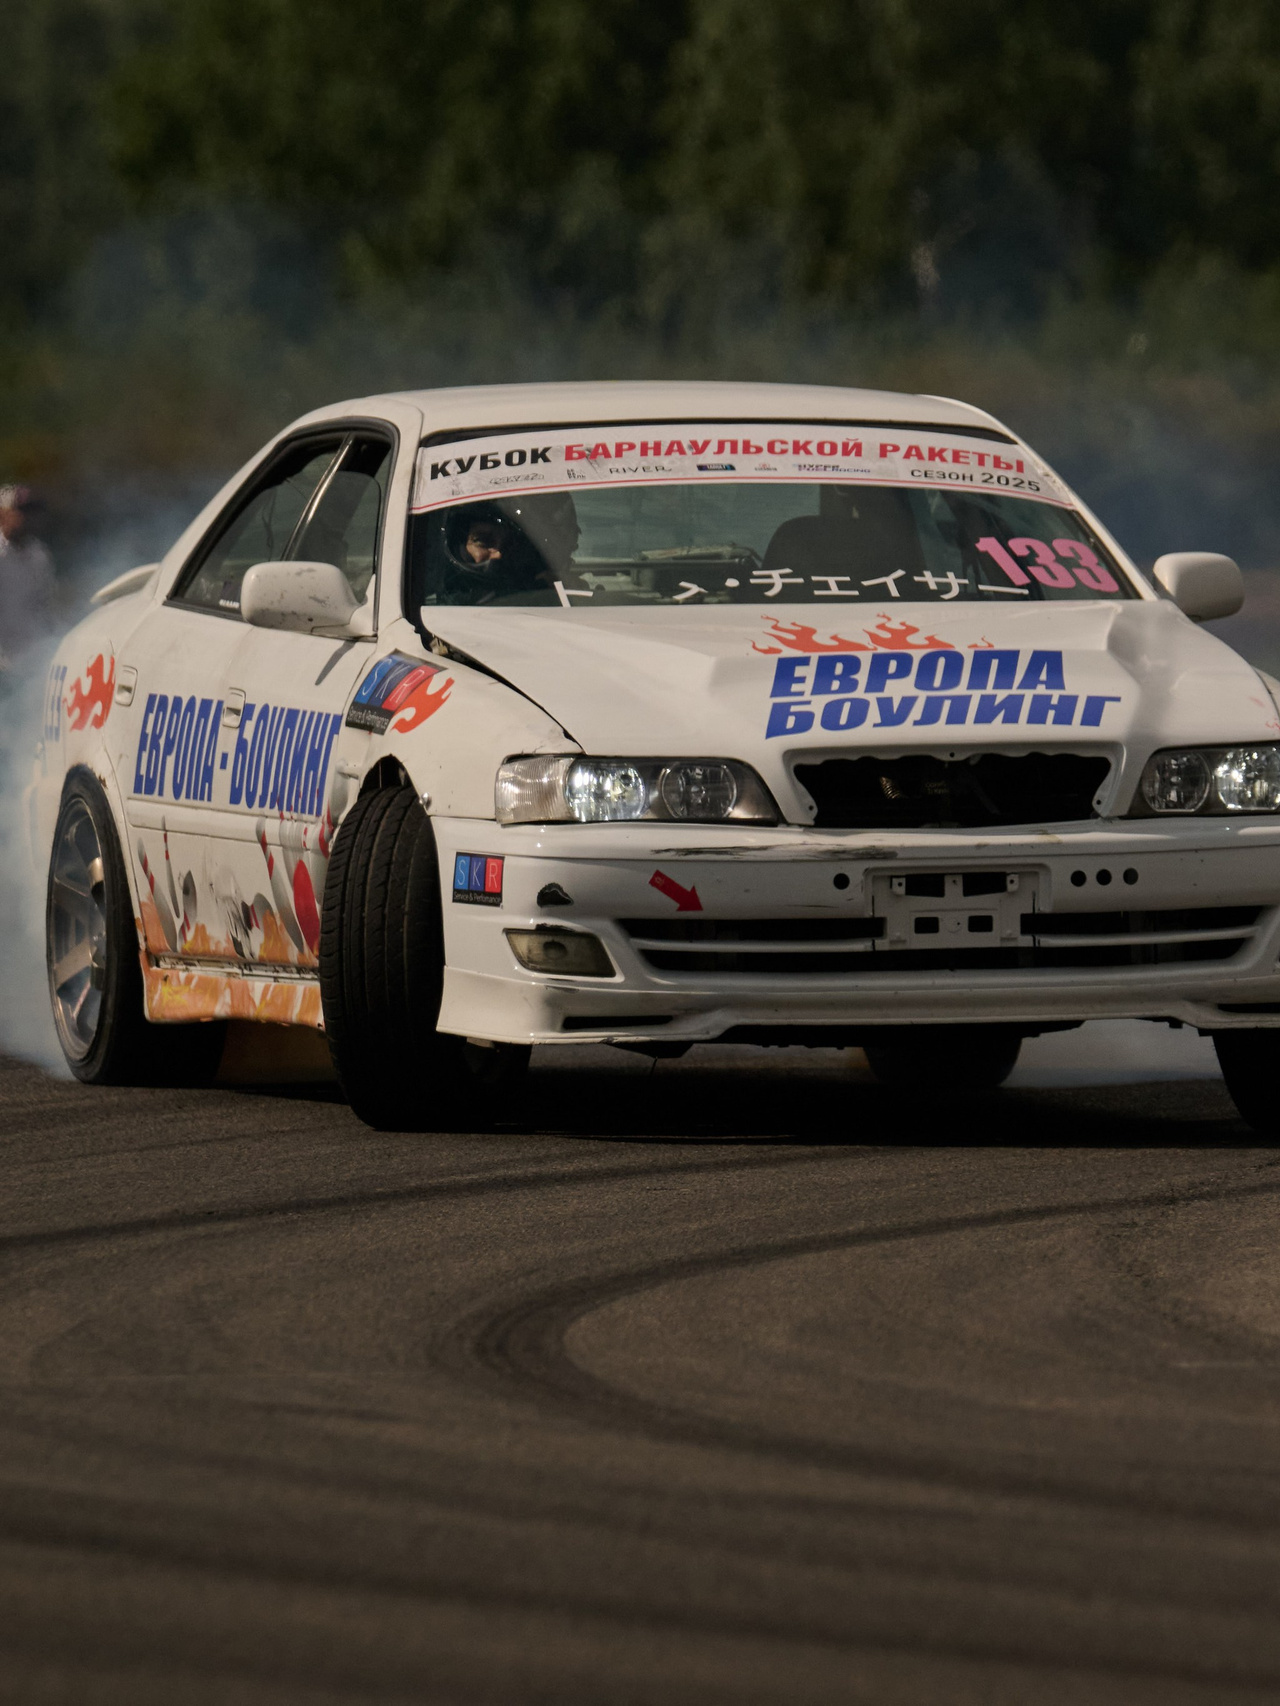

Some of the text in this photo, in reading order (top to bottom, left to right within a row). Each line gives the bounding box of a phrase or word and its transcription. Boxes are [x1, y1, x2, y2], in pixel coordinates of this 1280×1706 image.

[430, 438, 1025, 480] КУБОК БАРНАУЛЬСКОЙ РАКЕТЫ
[910, 469, 1040, 492] СЕЗОН 2025
[975, 536, 1120, 593] 133
[362, 658, 425, 703] SKR
[769, 649, 1066, 698] ЕВРОПА
[765, 694, 1122, 740] БОУЛИНГ
[457, 859, 498, 889] SKR
